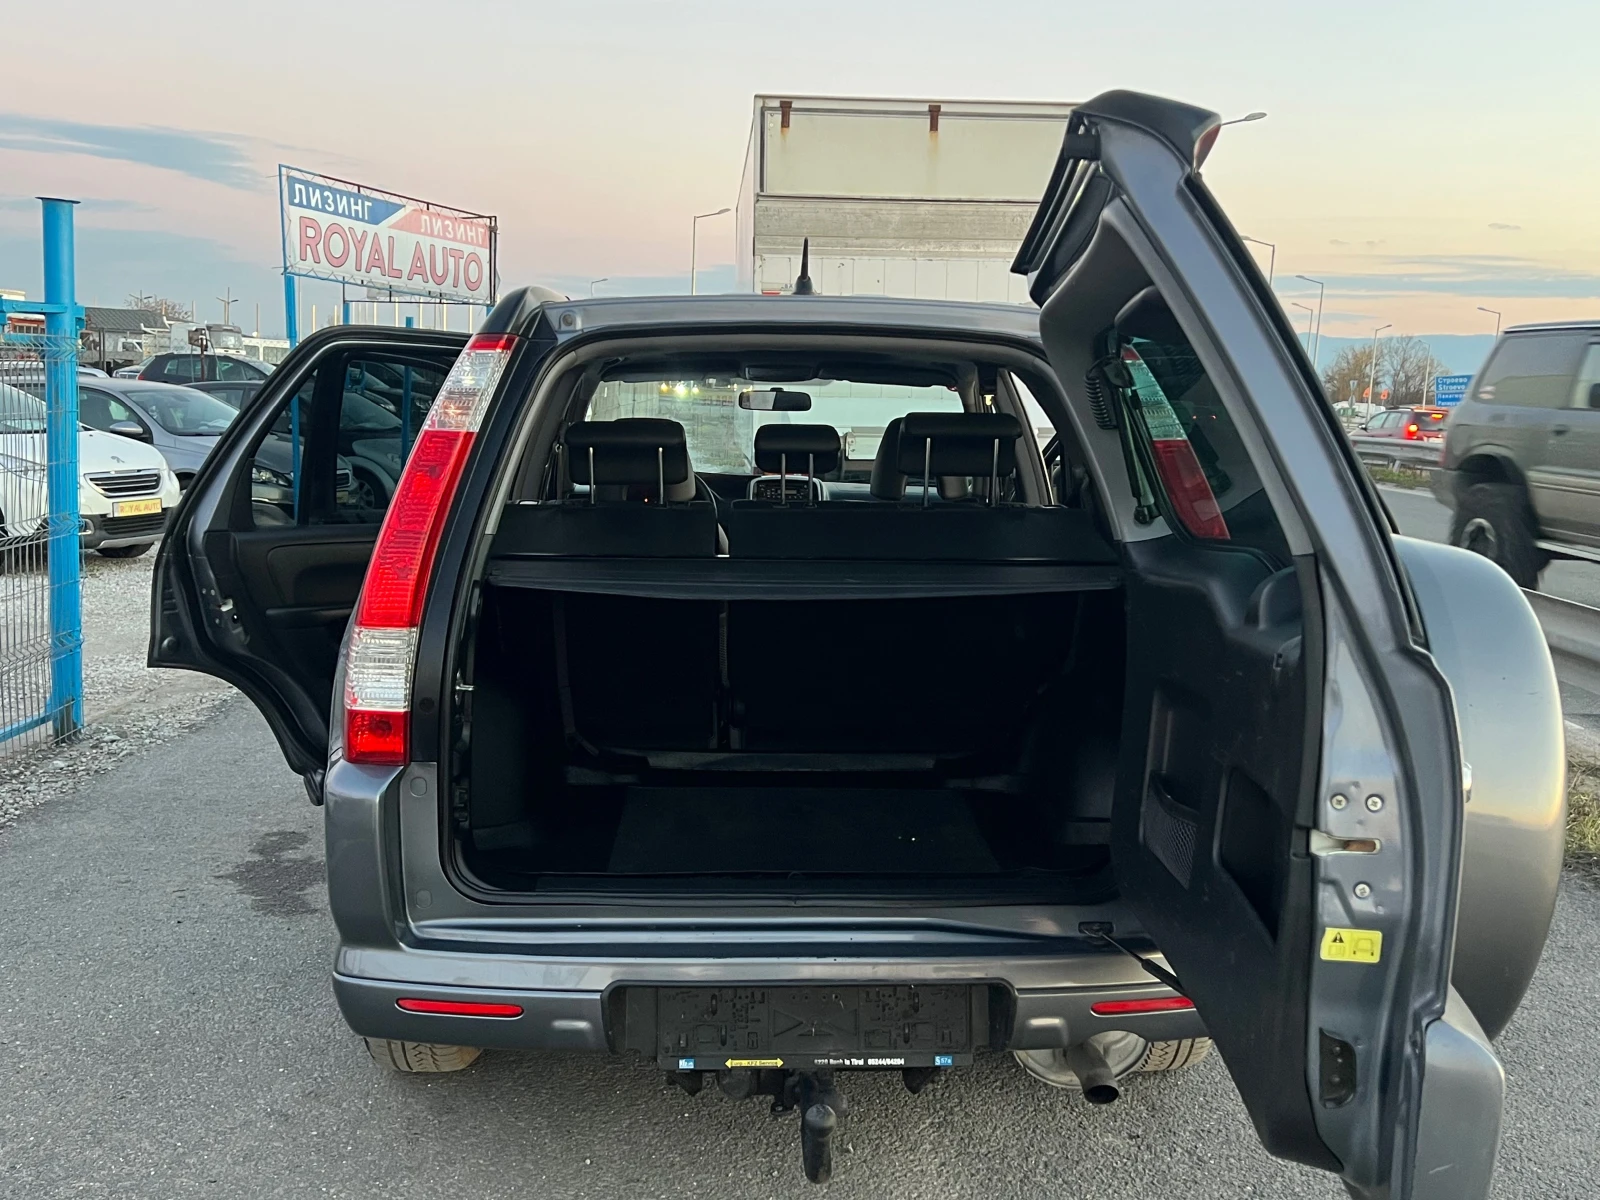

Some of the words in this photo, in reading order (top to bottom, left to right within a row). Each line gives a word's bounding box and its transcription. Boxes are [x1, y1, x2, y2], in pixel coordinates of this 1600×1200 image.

[293, 183, 373, 221] ЛИЗИНГ
[420, 215, 485, 245] ЛИЗИНГ
[299, 215, 403, 279] ROYAL
[407, 240, 483, 292] AUTO
